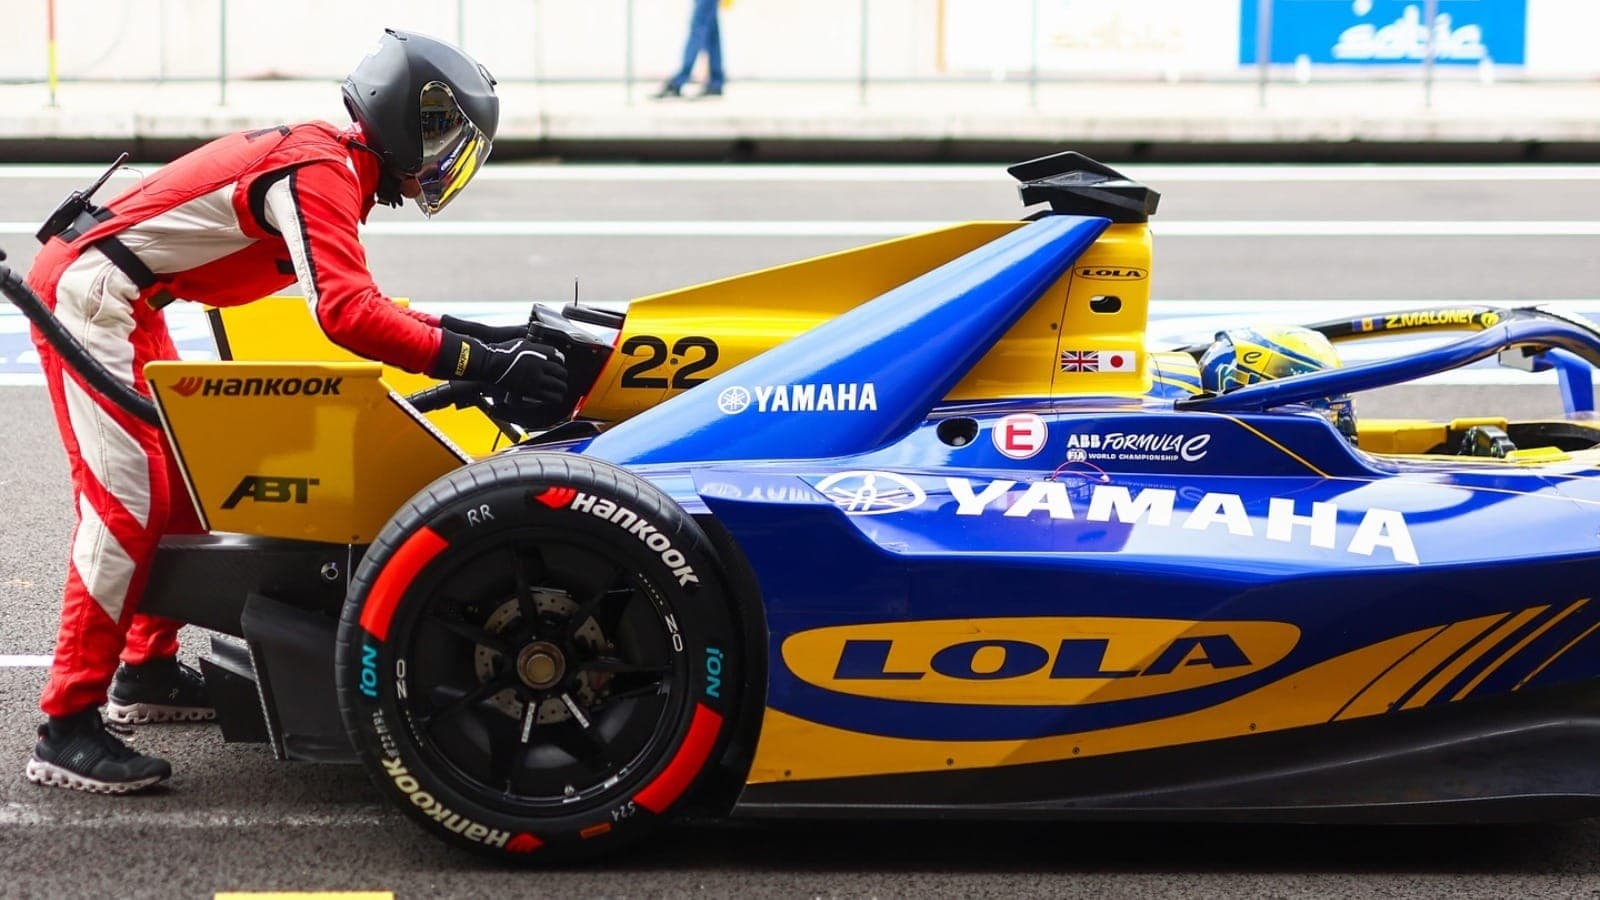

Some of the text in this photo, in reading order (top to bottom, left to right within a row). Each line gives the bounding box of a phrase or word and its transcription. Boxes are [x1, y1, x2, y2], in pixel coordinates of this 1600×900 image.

[1081, 268, 1142, 278] LOLA
[620, 335, 719, 390] 22
[755, 383, 878, 412] YAMAHA
[1067, 434, 1100, 448] ABB
[1101, 433, 1184, 451] FORMULA
[1088, 452, 1117, 460] WORLD
[1118, 453, 1179, 461] CHAMPIONSHIP
[220, 475, 320, 509] ABT
[466, 503, 495, 528] RR
[944, 477, 1420, 565] YAMAHA
[833, 634, 1253, 680] LOLA
